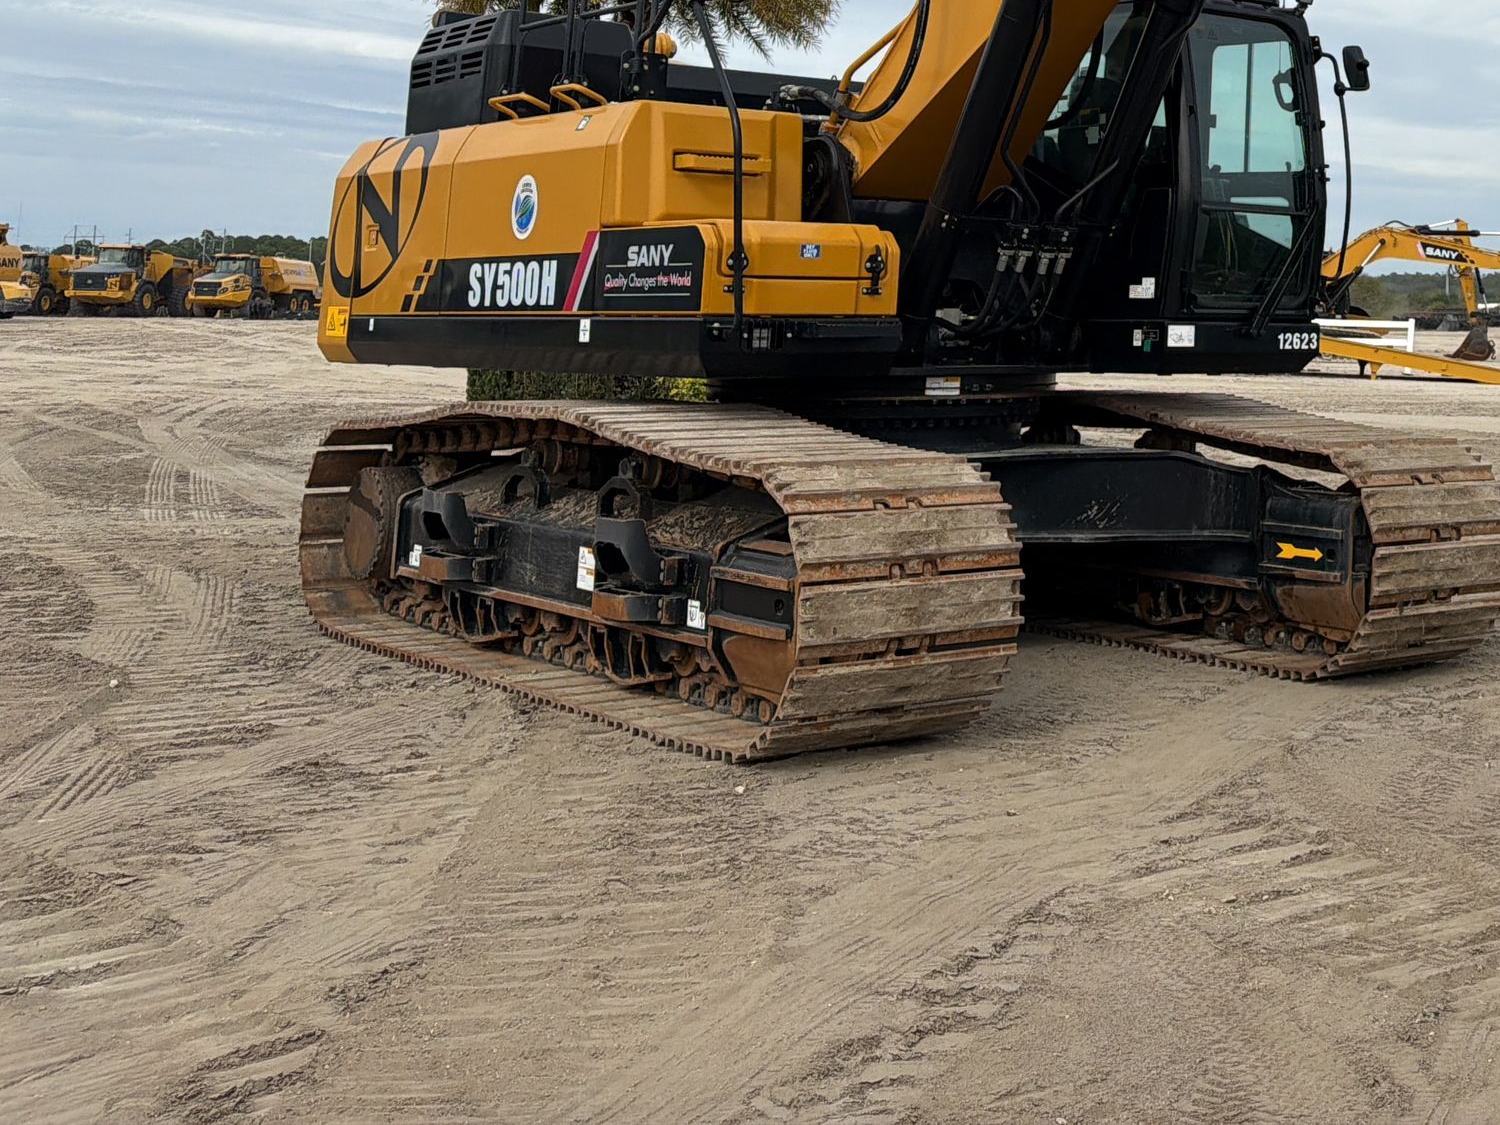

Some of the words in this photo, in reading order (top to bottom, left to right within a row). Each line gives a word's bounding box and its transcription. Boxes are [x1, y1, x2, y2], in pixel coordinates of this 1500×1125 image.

[627, 244, 674, 267] SANY
[1425, 246, 1459, 259] SANY
[0, 257, 20, 268] ANY
[468, 260, 558, 307] SY500H
[604, 273, 628, 291] Quality
[628, 271, 657, 291] Changes
[657, 270, 669, 287] the
[669, 270, 692, 287] World
[1277, 332, 1318, 350] 12623
